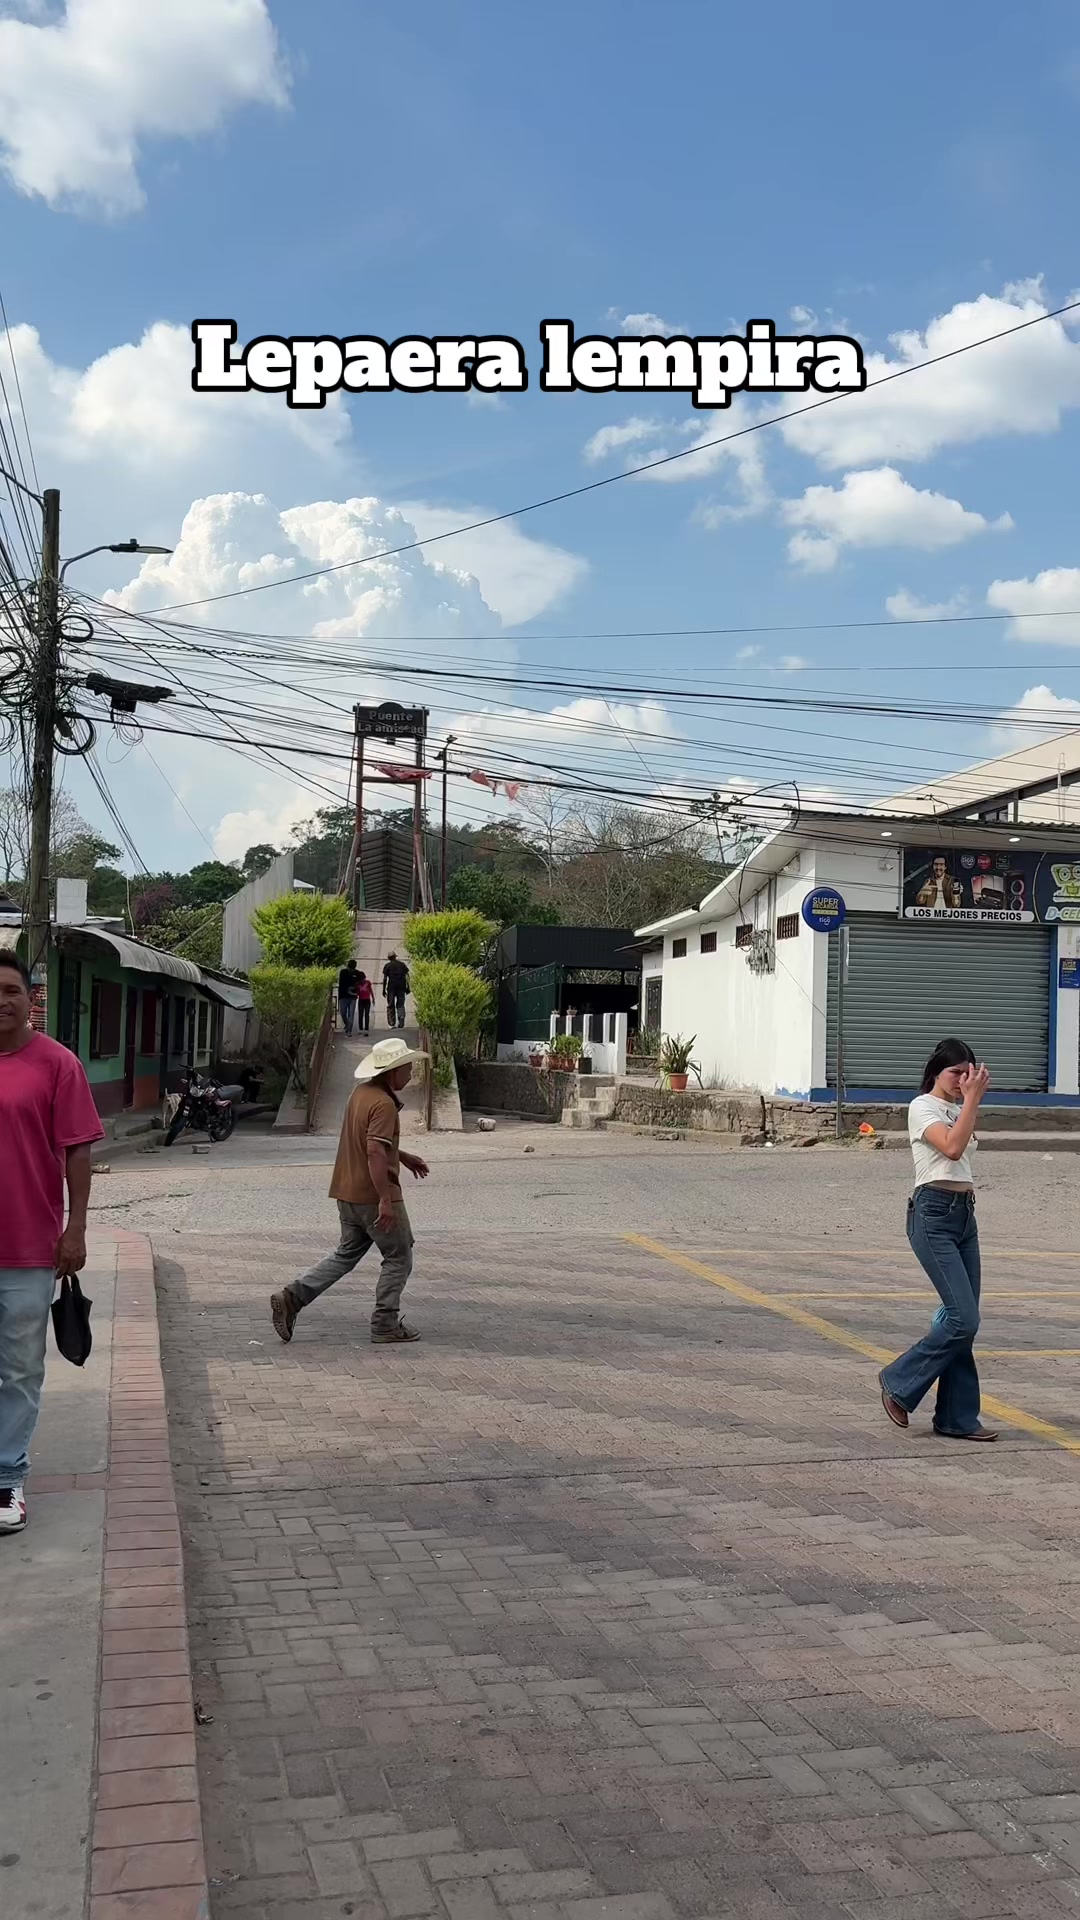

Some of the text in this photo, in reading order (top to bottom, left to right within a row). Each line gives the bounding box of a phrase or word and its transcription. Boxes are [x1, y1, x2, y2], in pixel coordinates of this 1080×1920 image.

[369, 710, 413, 721] Puente
[358, 723, 372, 732] La
[812, 896, 839, 905] SUPER
[913, 908, 1022, 921] LOS MEJORES PRECIOS
[819, 916, 831, 926] tigo
